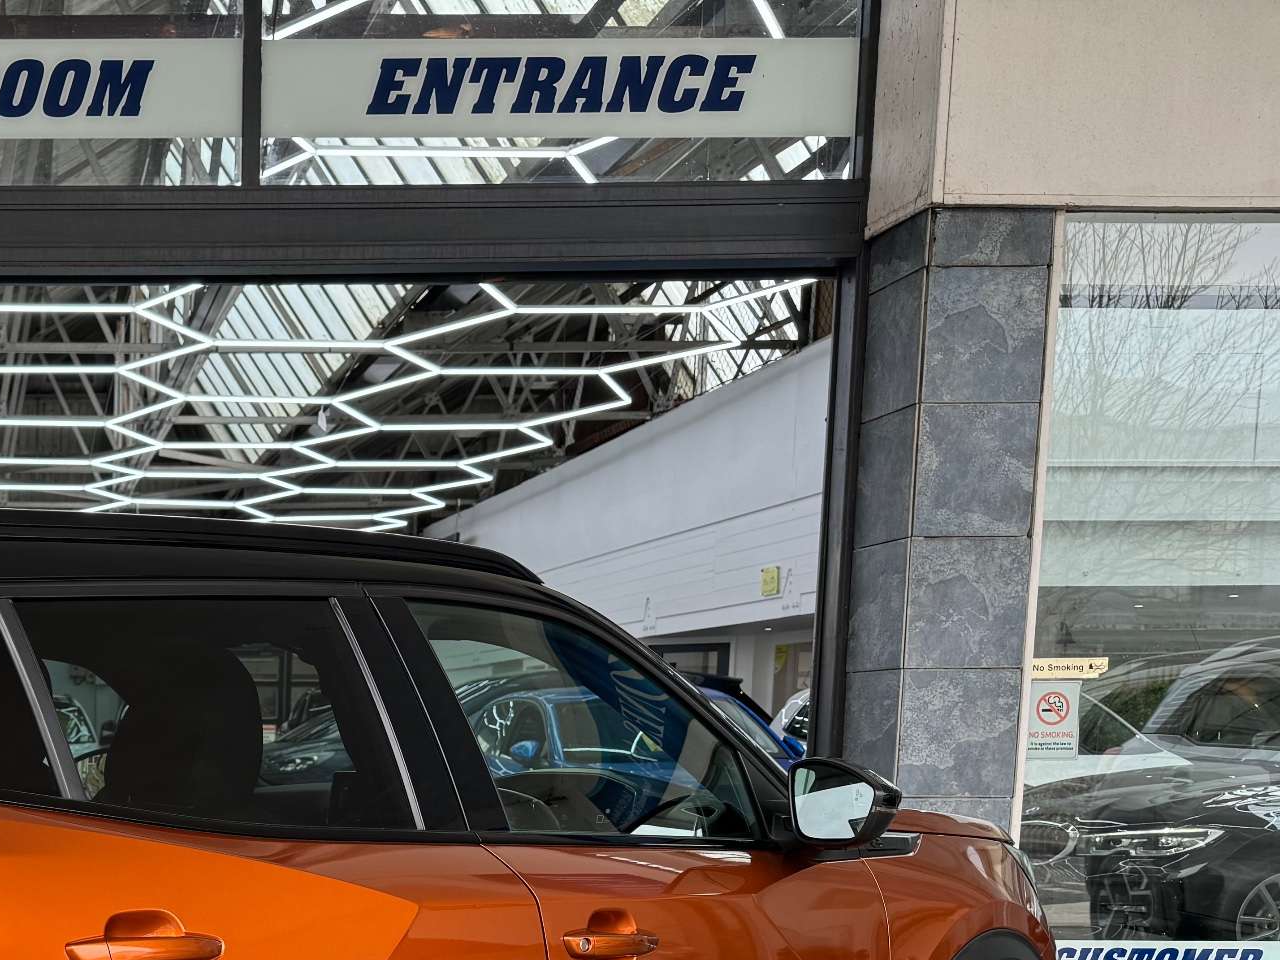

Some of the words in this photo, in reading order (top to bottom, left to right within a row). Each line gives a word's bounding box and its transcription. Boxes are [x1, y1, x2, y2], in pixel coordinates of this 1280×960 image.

[366, 54, 758, 115] ENTRANCE
[1032, 664, 1045, 672] No
[1047, 663, 1084, 673] Smoking
[1028, 731, 1040, 739] NO
